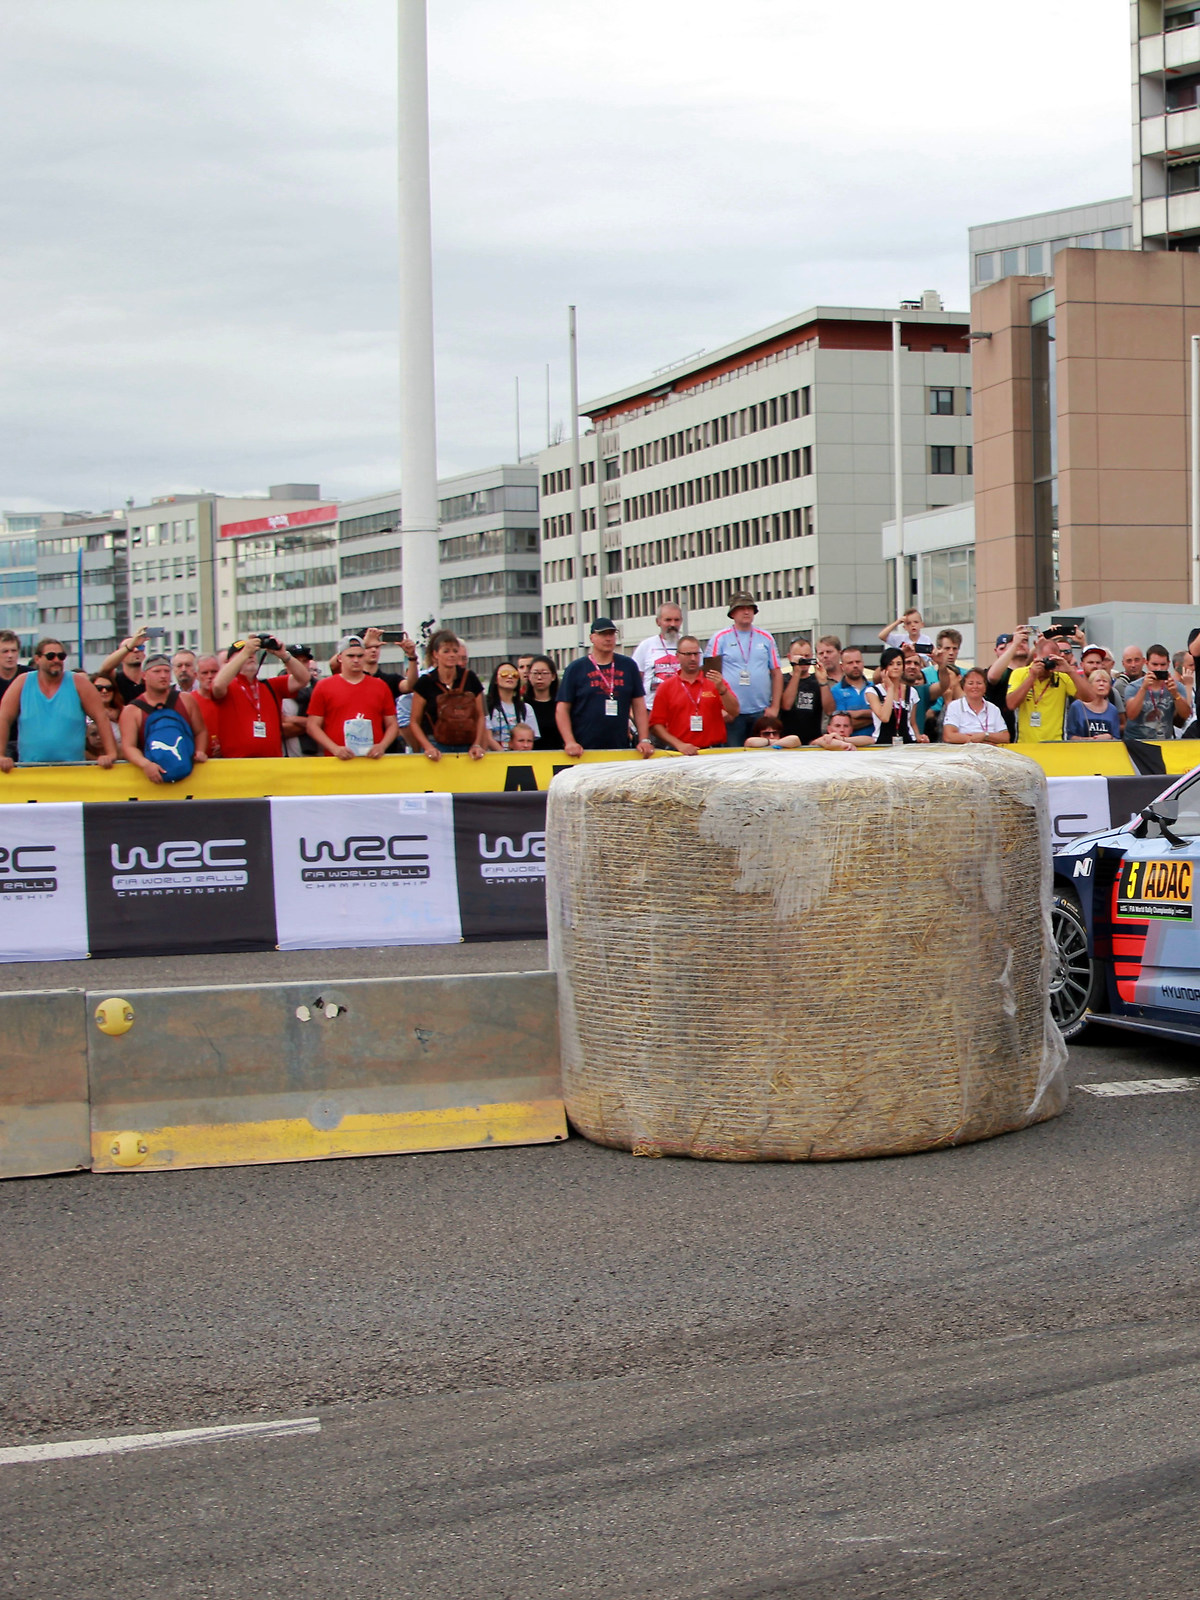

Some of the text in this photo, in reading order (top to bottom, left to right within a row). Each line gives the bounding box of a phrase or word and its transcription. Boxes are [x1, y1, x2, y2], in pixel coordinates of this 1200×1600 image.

[300, 835, 429, 862] WRC
[111, 839, 247, 870] WRC
[142, 876, 192, 885] WORLD
[195, 874, 244, 882] RALLY
[305, 881, 428, 889] CHAMPIONSHIP
[1127, 862, 1191, 900] 5 ADAC
[3, 881, 54, 890] RALLY
[117, 886, 245, 897] CHAMPIONSHIP
